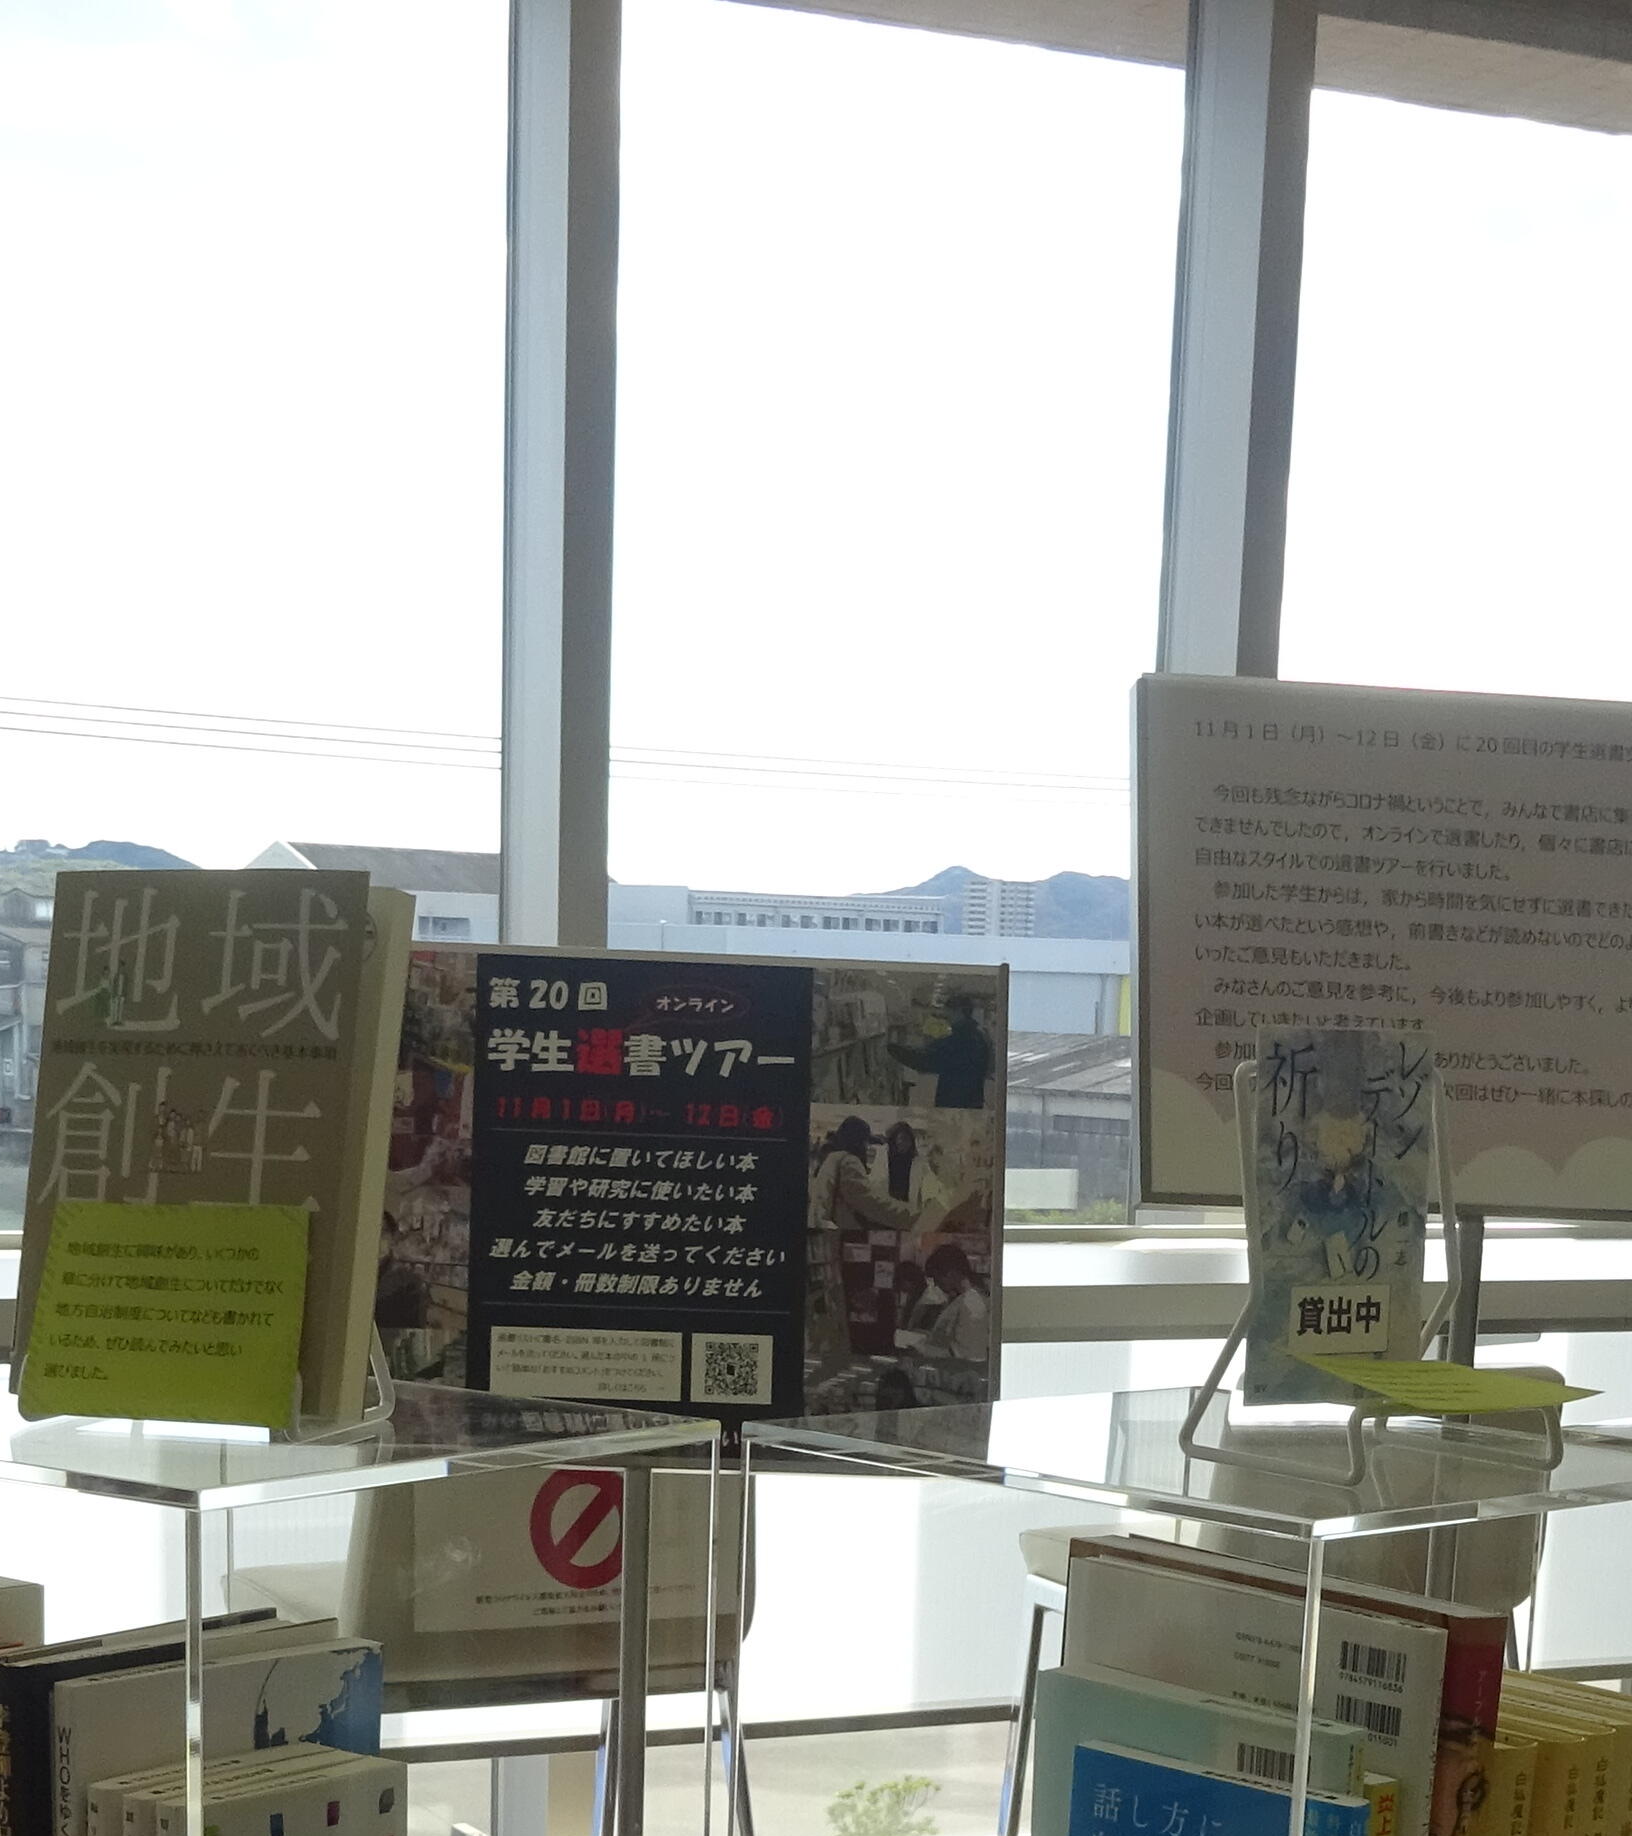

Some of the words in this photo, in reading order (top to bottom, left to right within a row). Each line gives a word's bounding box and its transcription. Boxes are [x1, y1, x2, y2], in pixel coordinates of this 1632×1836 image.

[56, 885, 349, 1042] 地域
[656, 995, 736, 1014] オンライン
[487, 1028, 796, 1078] 学生選書ツアー
[1391, 1040, 1429, 1160] レゾン
[37, 1061, 321, 1213] 創生
[1263, 1041, 1319, 1197] 祈り
[523, 1143, 760, 1173] 図書館に置いてほしい本
[523, 1175, 759, 1203] 学習や研究に使いたい本
[532, 1208, 748, 1235] 友だちにすすめたい本
[488, 1237, 787, 1268] 選んでメールを送ってください
[508, 1269, 764, 1300] 金額・冊数制限ありません
[1296, 1294, 1383, 1336] 貸出中
